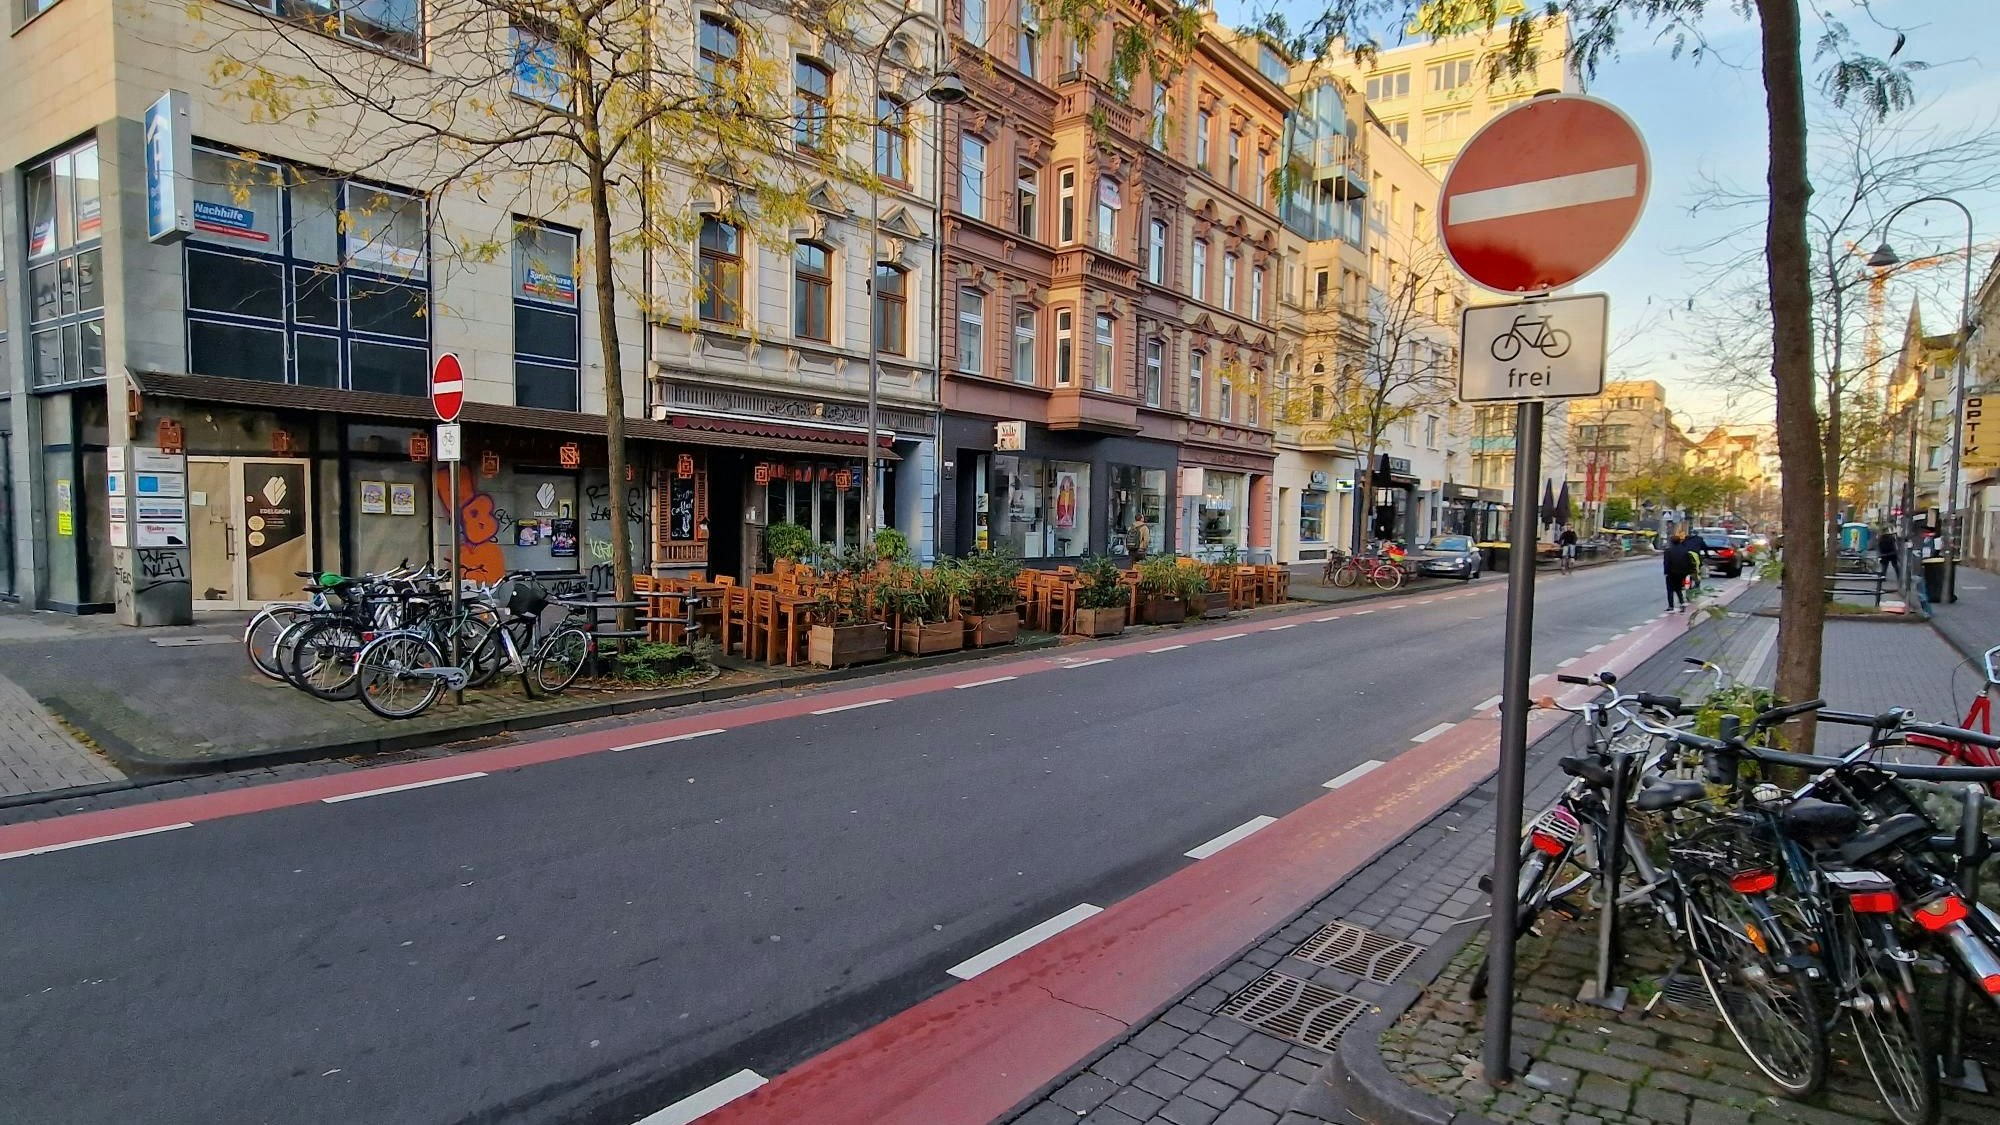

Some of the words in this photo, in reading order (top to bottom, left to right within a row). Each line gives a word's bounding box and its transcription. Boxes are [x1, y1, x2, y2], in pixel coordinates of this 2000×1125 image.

[195, 202, 244, 221] Nachhilfe
[1508, 366, 1551, 388] frei
[1964, 398, 1983, 456] OPTIK
